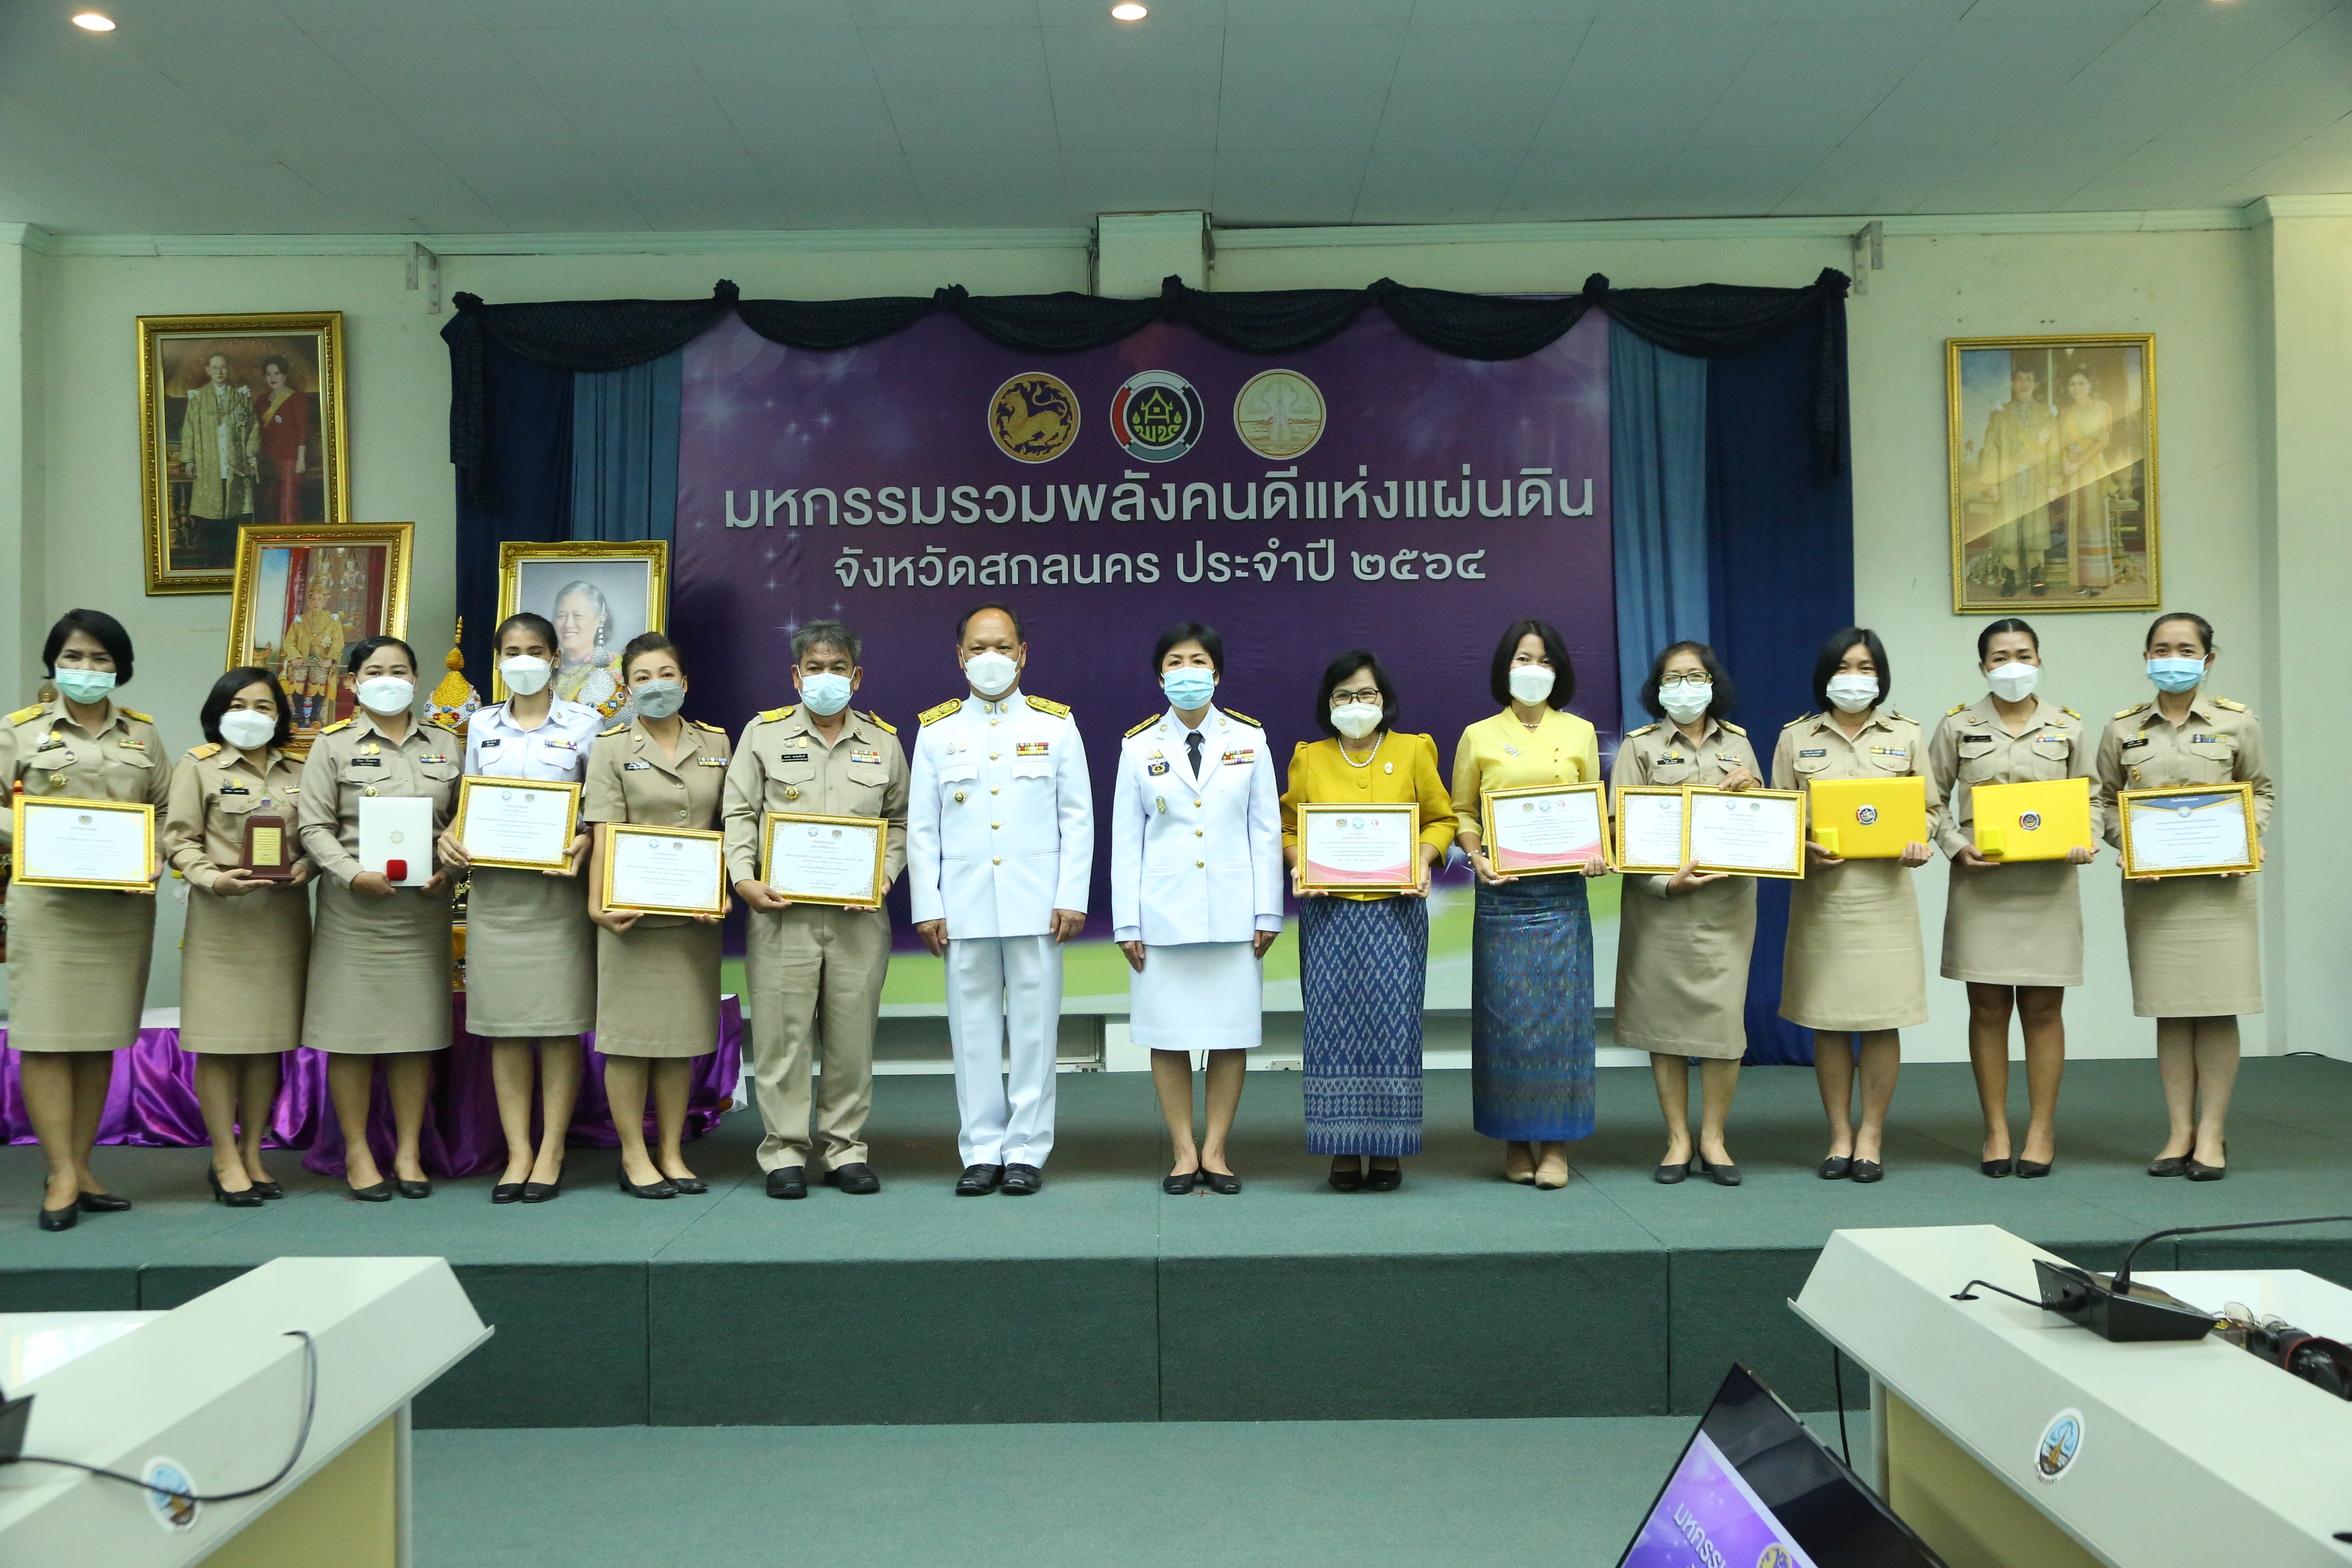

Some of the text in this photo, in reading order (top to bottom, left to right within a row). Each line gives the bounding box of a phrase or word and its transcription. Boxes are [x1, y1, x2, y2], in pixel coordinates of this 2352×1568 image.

[725, 464, 1594, 528] มหกรรมรวมพลังคนดีแห่งแผ่นดิน
[834, 537, 1486, 588] จังหวัดสกลนคร ประจำปี ๒๕๖๔
